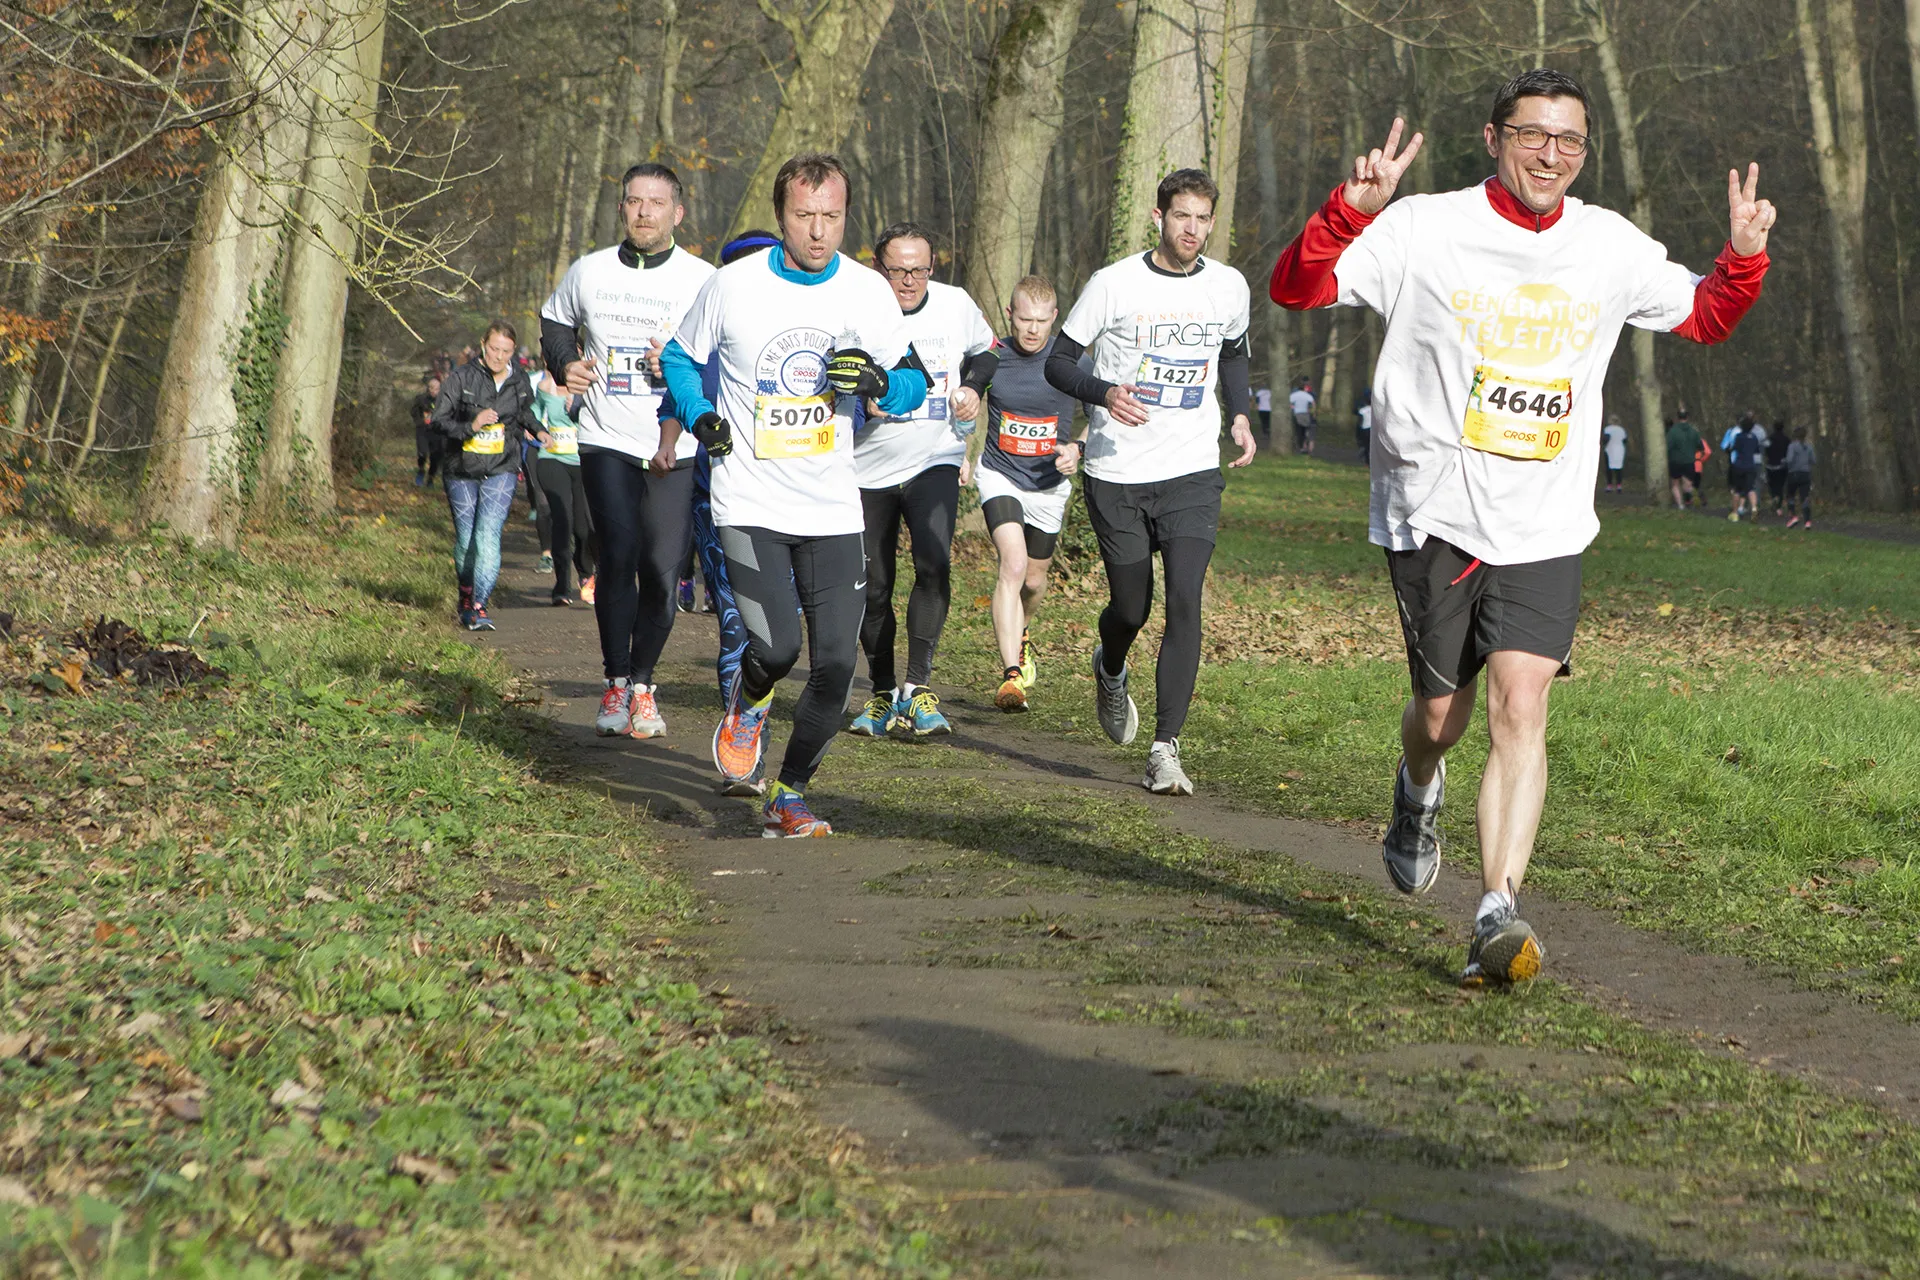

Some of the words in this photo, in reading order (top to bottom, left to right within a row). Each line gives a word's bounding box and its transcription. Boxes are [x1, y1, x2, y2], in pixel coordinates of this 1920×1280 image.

[596, 289, 621, 304] Easy
[624, 293, 671, 311] Running
[1137, 311, 1204, 323] RUNNING
[777, 333, 800, 353] BATS
[804, 332, 828, 351] POUR
[914, 338, 945, 349] nning
[624, 357, 646, 371] 16
[765, 349, 782, 364] ME
[760, 366, 775, 378] JE
[793, 370, 817, 378] CROSS
[1153, 367, 1197, 384] 1427
[1488, 386, 1561, 418] 4646
[770, 406, 824, 426] 5070
[479, 432, 499, 440] 073
[1009, 423, 1047, 437] 6762
[786, 438, 811, 446] CROSS
[817, 431, 828, 445] 10
[1041, 441, 1051, 451] 15
[1503, 430, 1537, 442] CROSS
[1545, 430, 1560, 448] 10
